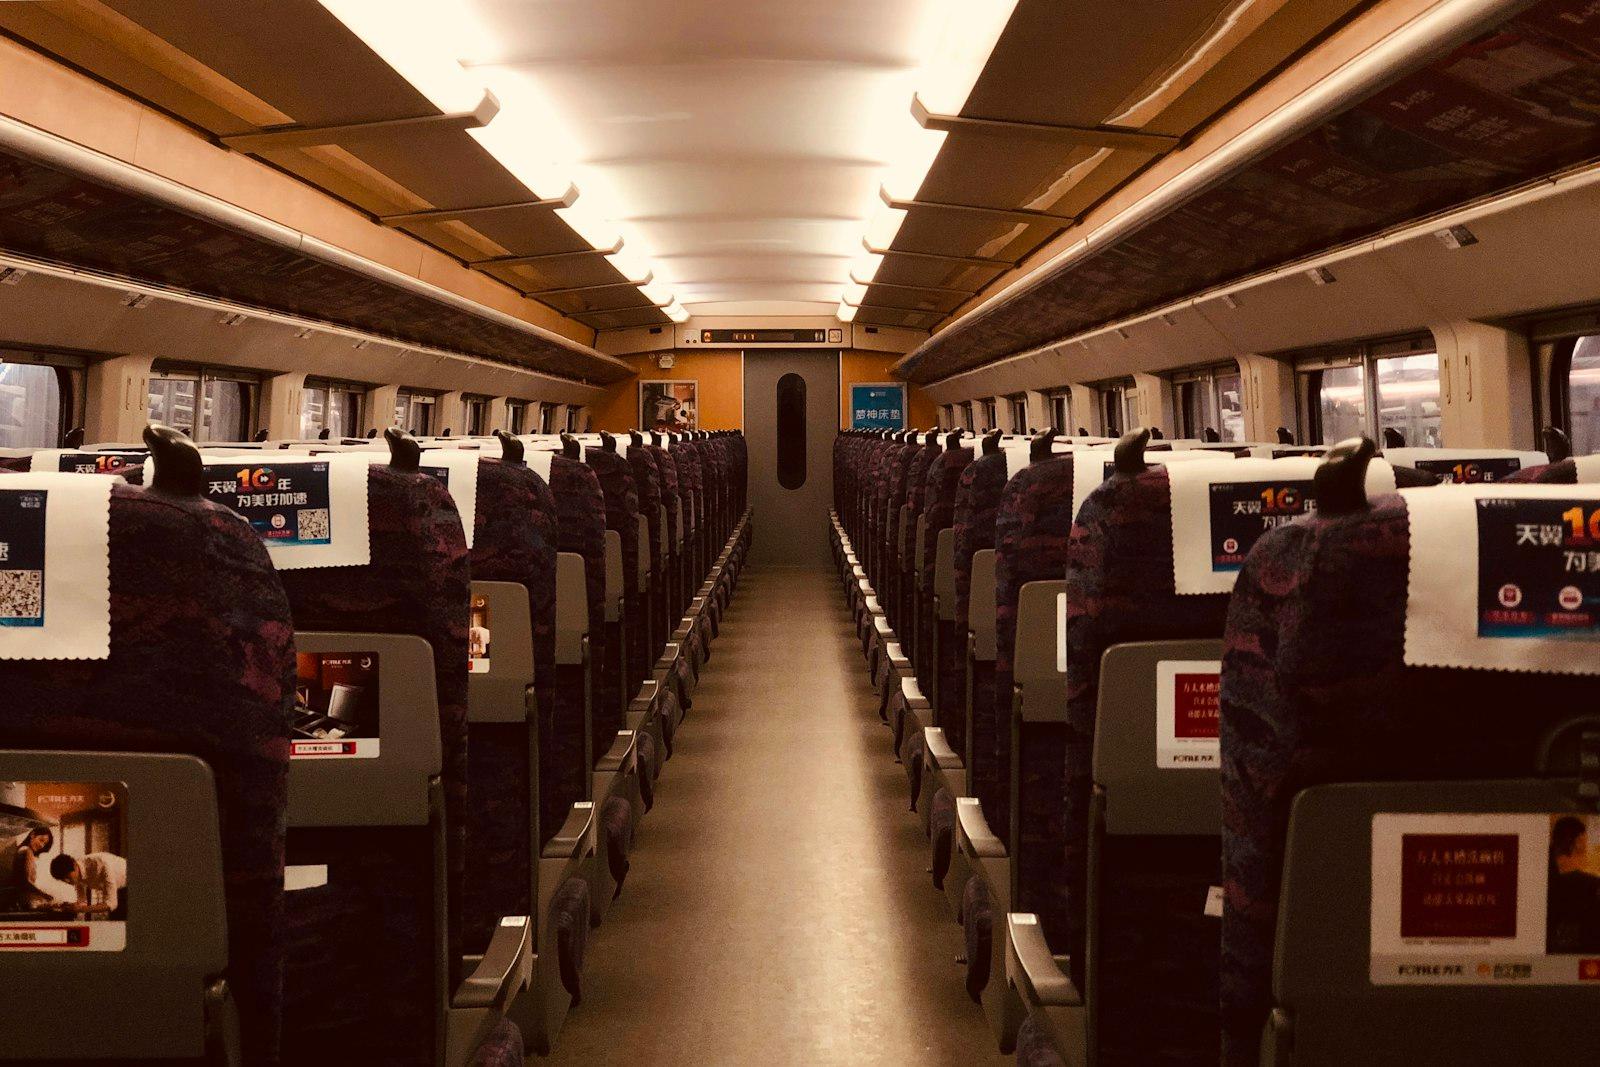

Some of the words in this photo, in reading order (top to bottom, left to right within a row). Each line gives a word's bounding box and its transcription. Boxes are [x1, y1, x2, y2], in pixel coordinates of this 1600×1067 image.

[208, 467, 292, 494] 天翼10年
[236, 492, 308, 507] 为美好加速
